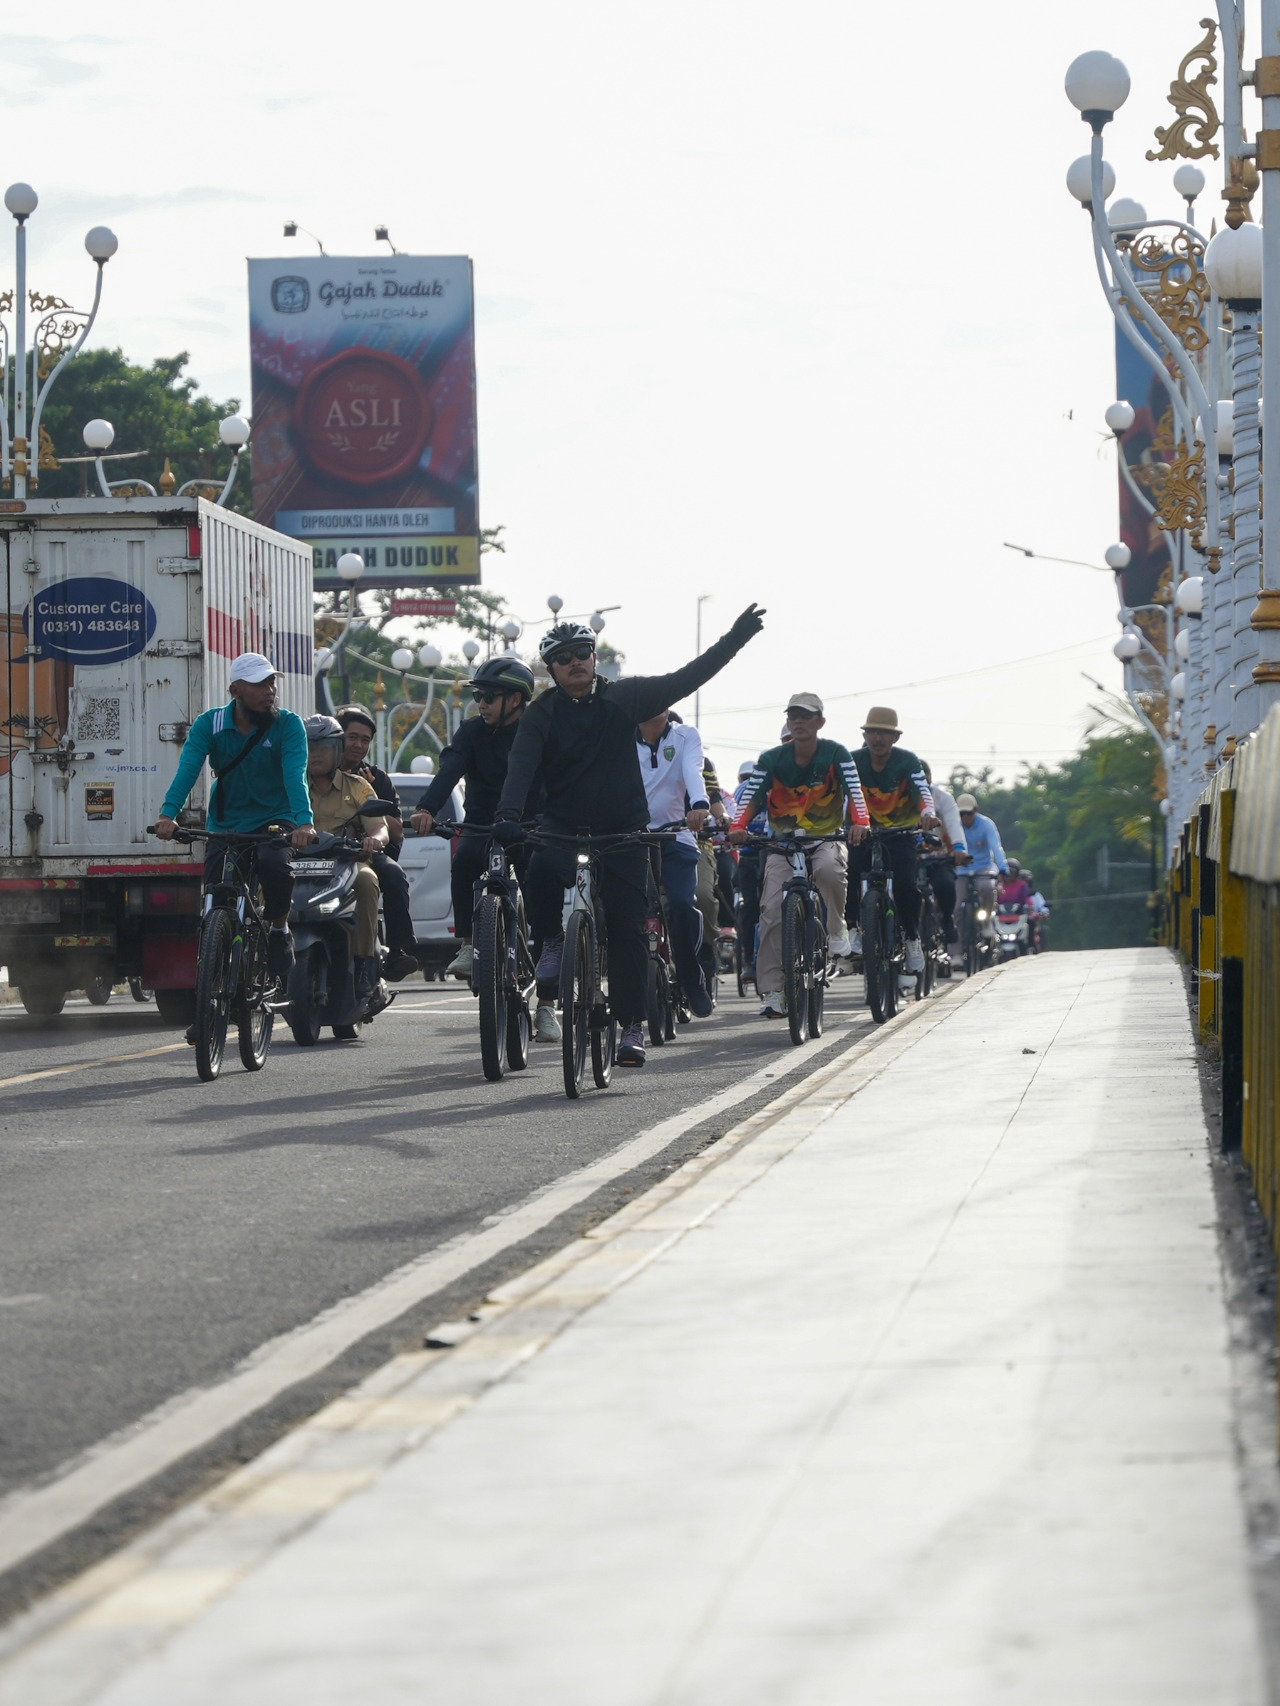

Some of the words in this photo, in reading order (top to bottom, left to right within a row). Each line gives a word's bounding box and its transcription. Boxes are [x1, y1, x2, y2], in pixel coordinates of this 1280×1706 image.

[319, 281, 376, 307] Gajah
[382, 280, 445, 298] Duduk
[323, 398, 402, 427] ASLI
[301, 514, 363, 529] DIPRODUKSI
[365, 513, 400, 528] HANYA
[402, 513, 429, 526] OLEH
[385, 544, 459, 567] DUDUK
[38, 602, 106, 615] Customer
[110, 601, 143, 613] Care
[42, 620, 83, 635] (0351)
[87, 620, 140, 631] 483648
